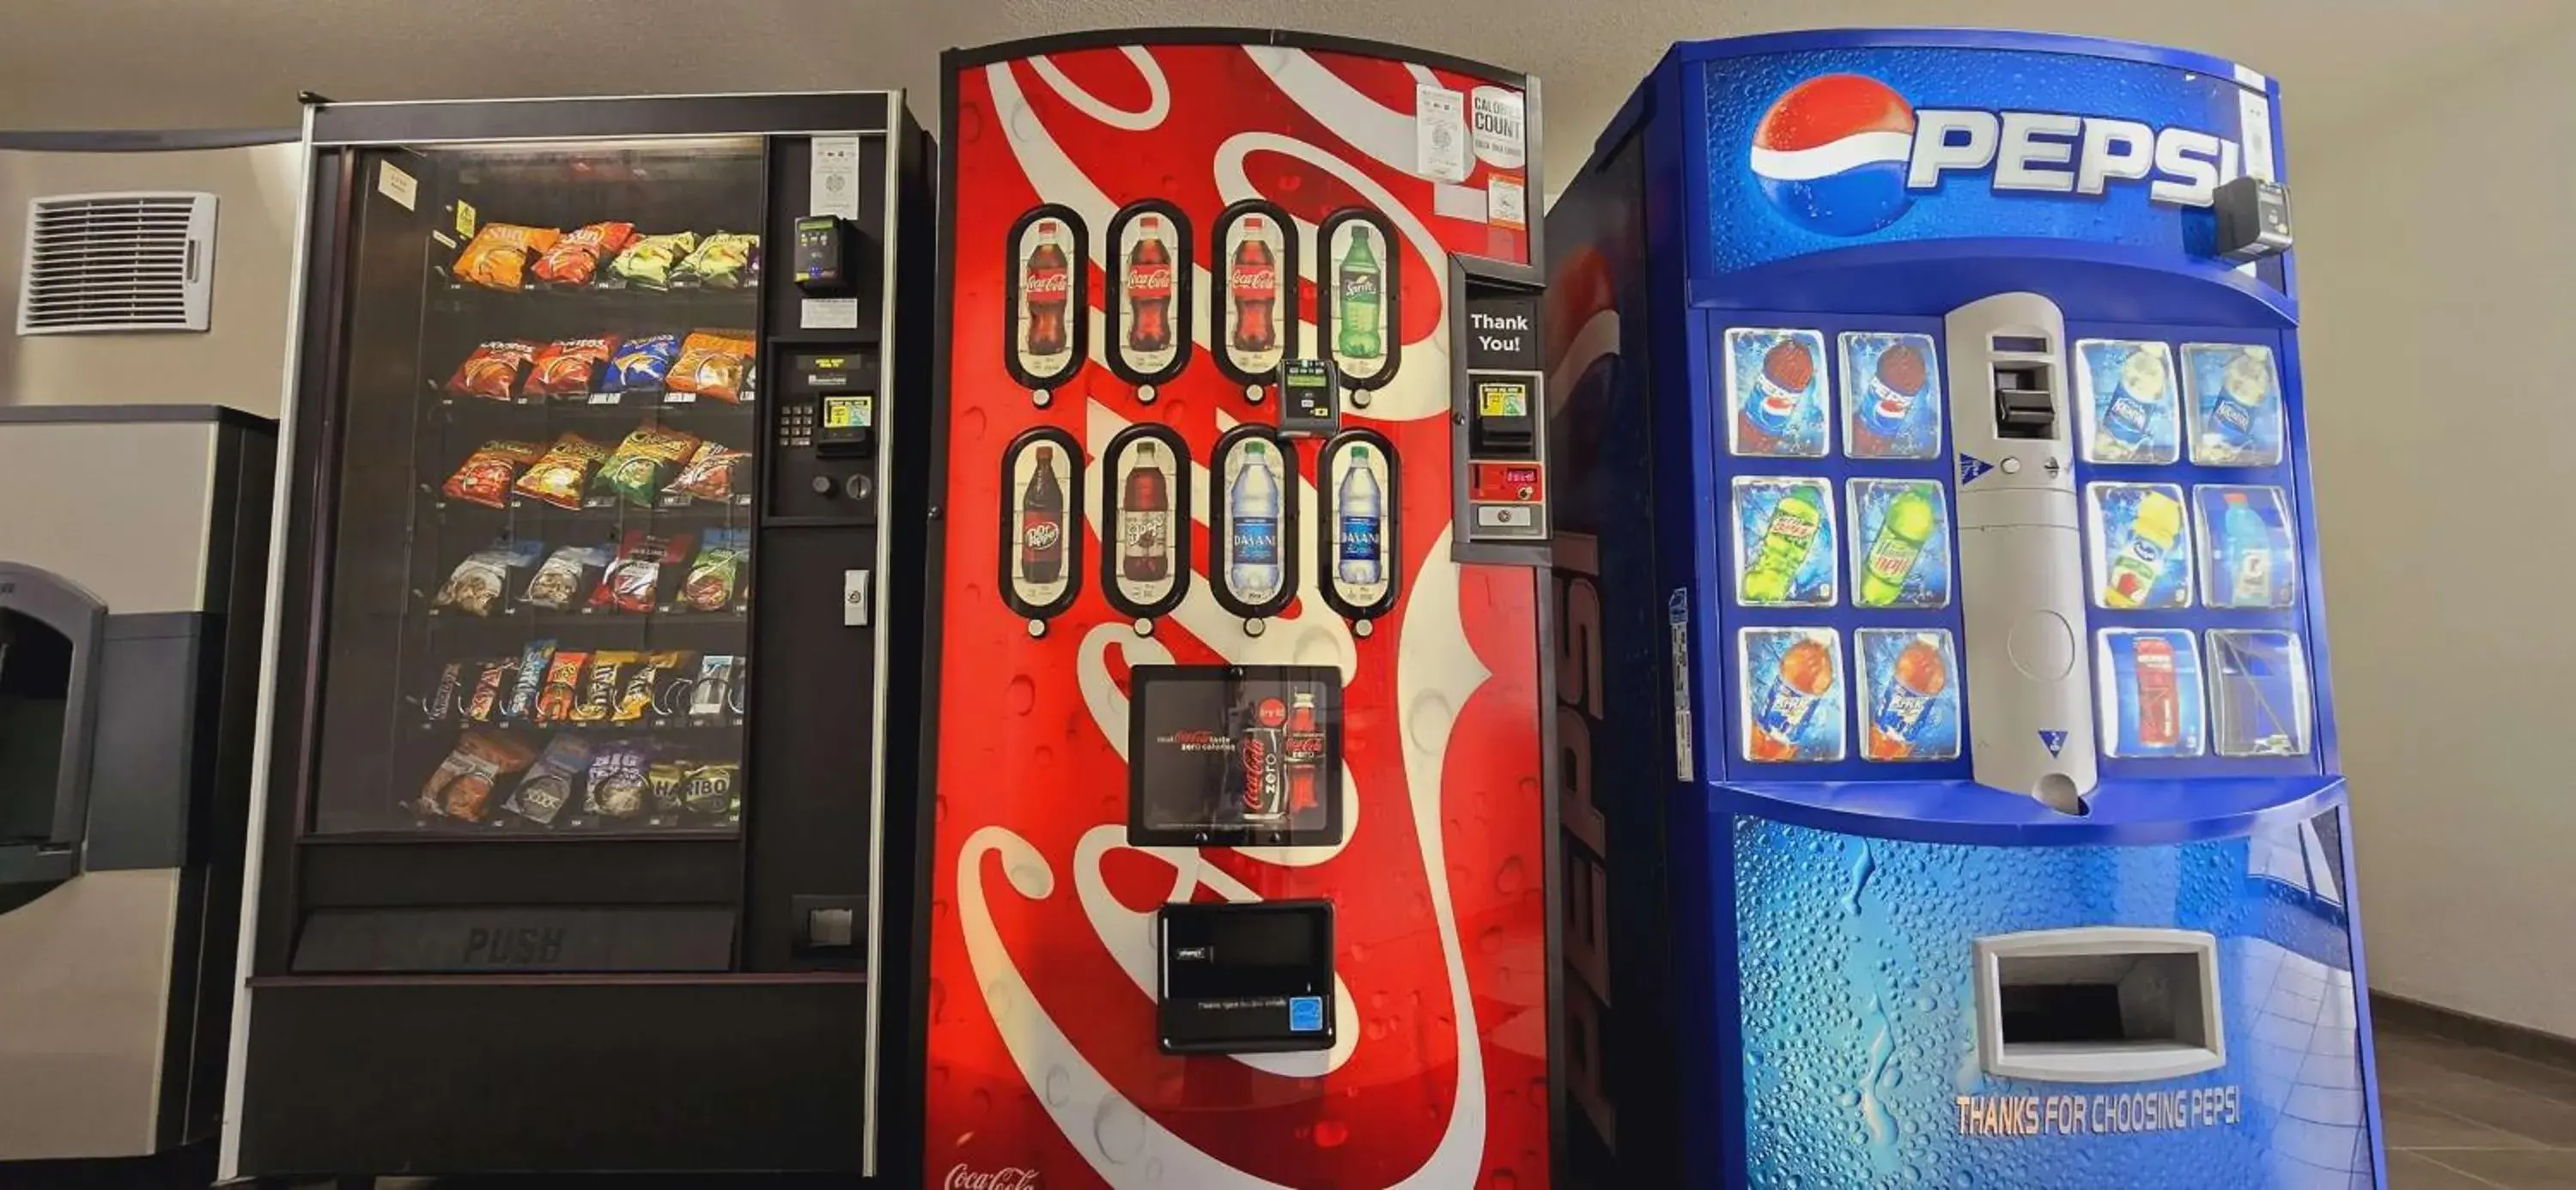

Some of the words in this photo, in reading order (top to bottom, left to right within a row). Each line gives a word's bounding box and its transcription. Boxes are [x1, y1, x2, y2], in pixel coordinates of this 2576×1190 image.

[1474, 112, 1522, 140] COUNT
[1906, 107, 2239, 208] PEPSI
[1470, 314, 1528, 331] Thank
[1479, 336, 1521, 352] You!
[1234, 535, 1276, 546] DASANI
[593, 753, 639, 768] BIG
[1242, 737, 1264, 811] Coca-Cola
[1265, 752, 1278, 794] zero
[463, 927, 566, 964] PUSH
[1956, 1096, 2040, 1136] THANKS
[2044, 1095, 2087, 1135] FOR
[2092, 1089, 2187, 1133] CHOOSING
[2190, 1084, 2240, 1126] PEPSI
